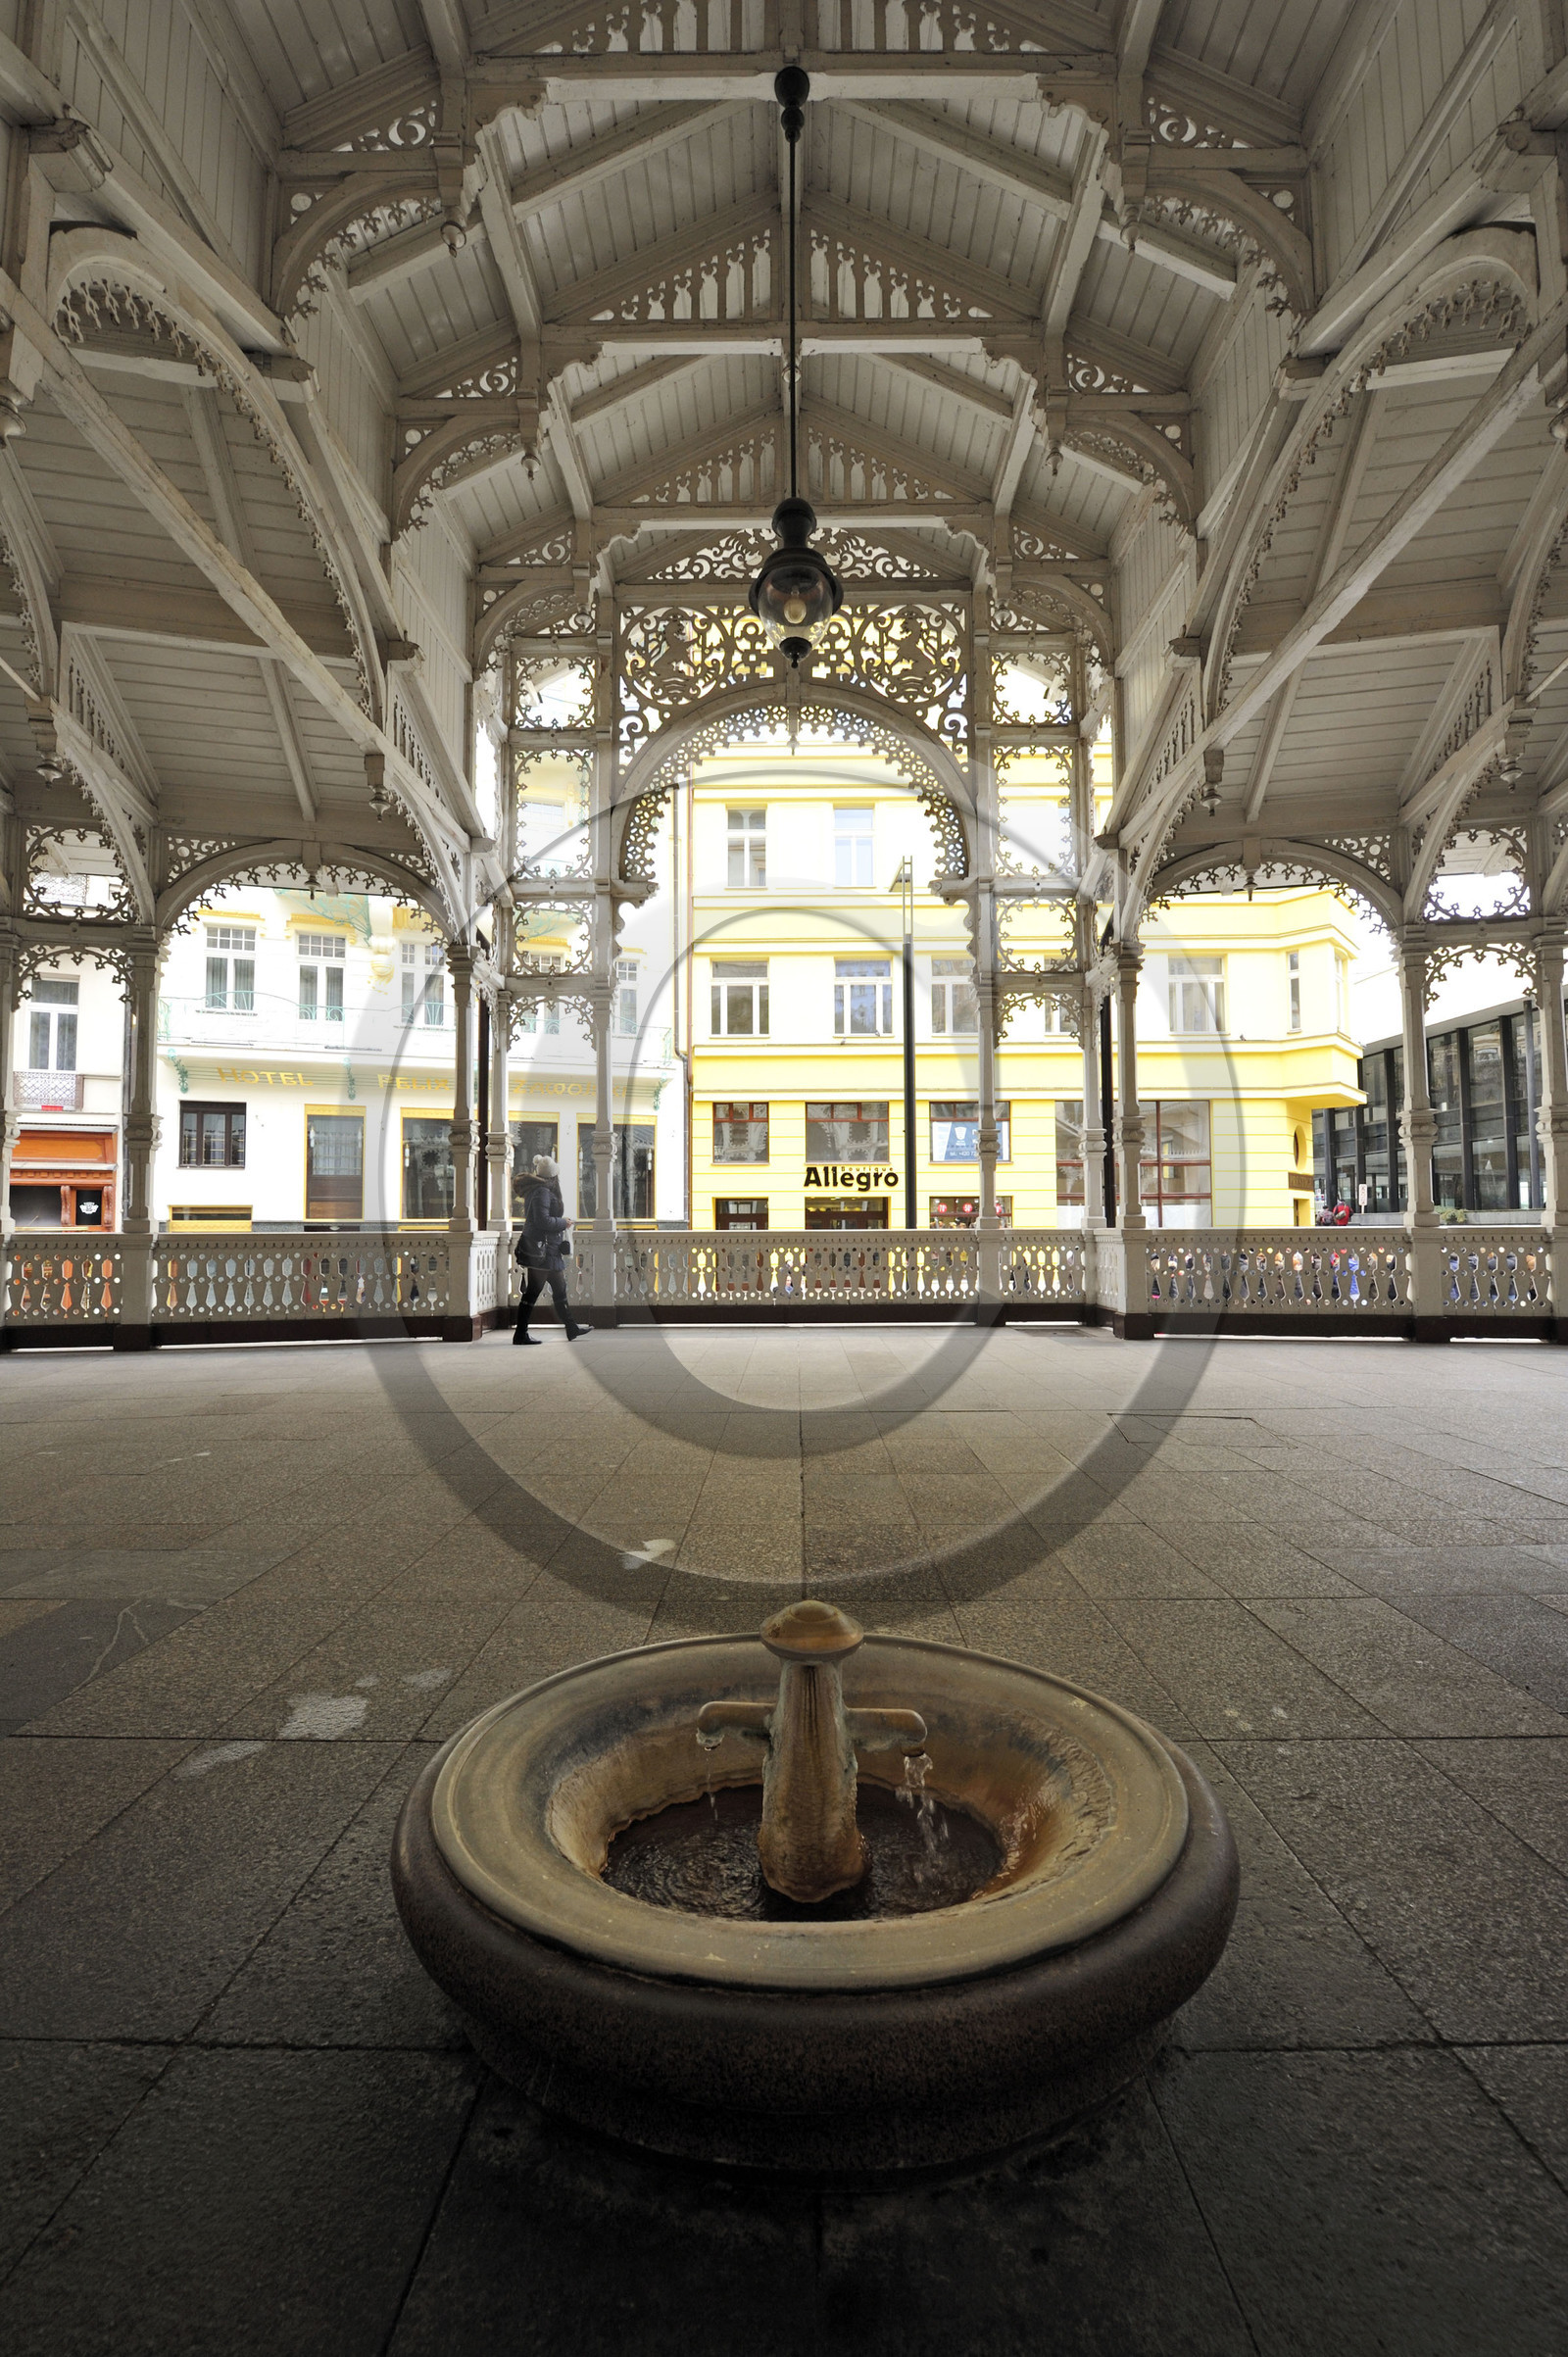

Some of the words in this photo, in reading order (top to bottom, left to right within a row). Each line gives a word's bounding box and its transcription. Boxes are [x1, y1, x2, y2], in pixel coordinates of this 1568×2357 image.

[217, 1066, 315, 1086] HOTEL
[376, 1074, 451, 1091] FELIX
[804, 1166, 899, 1192] Allegro
